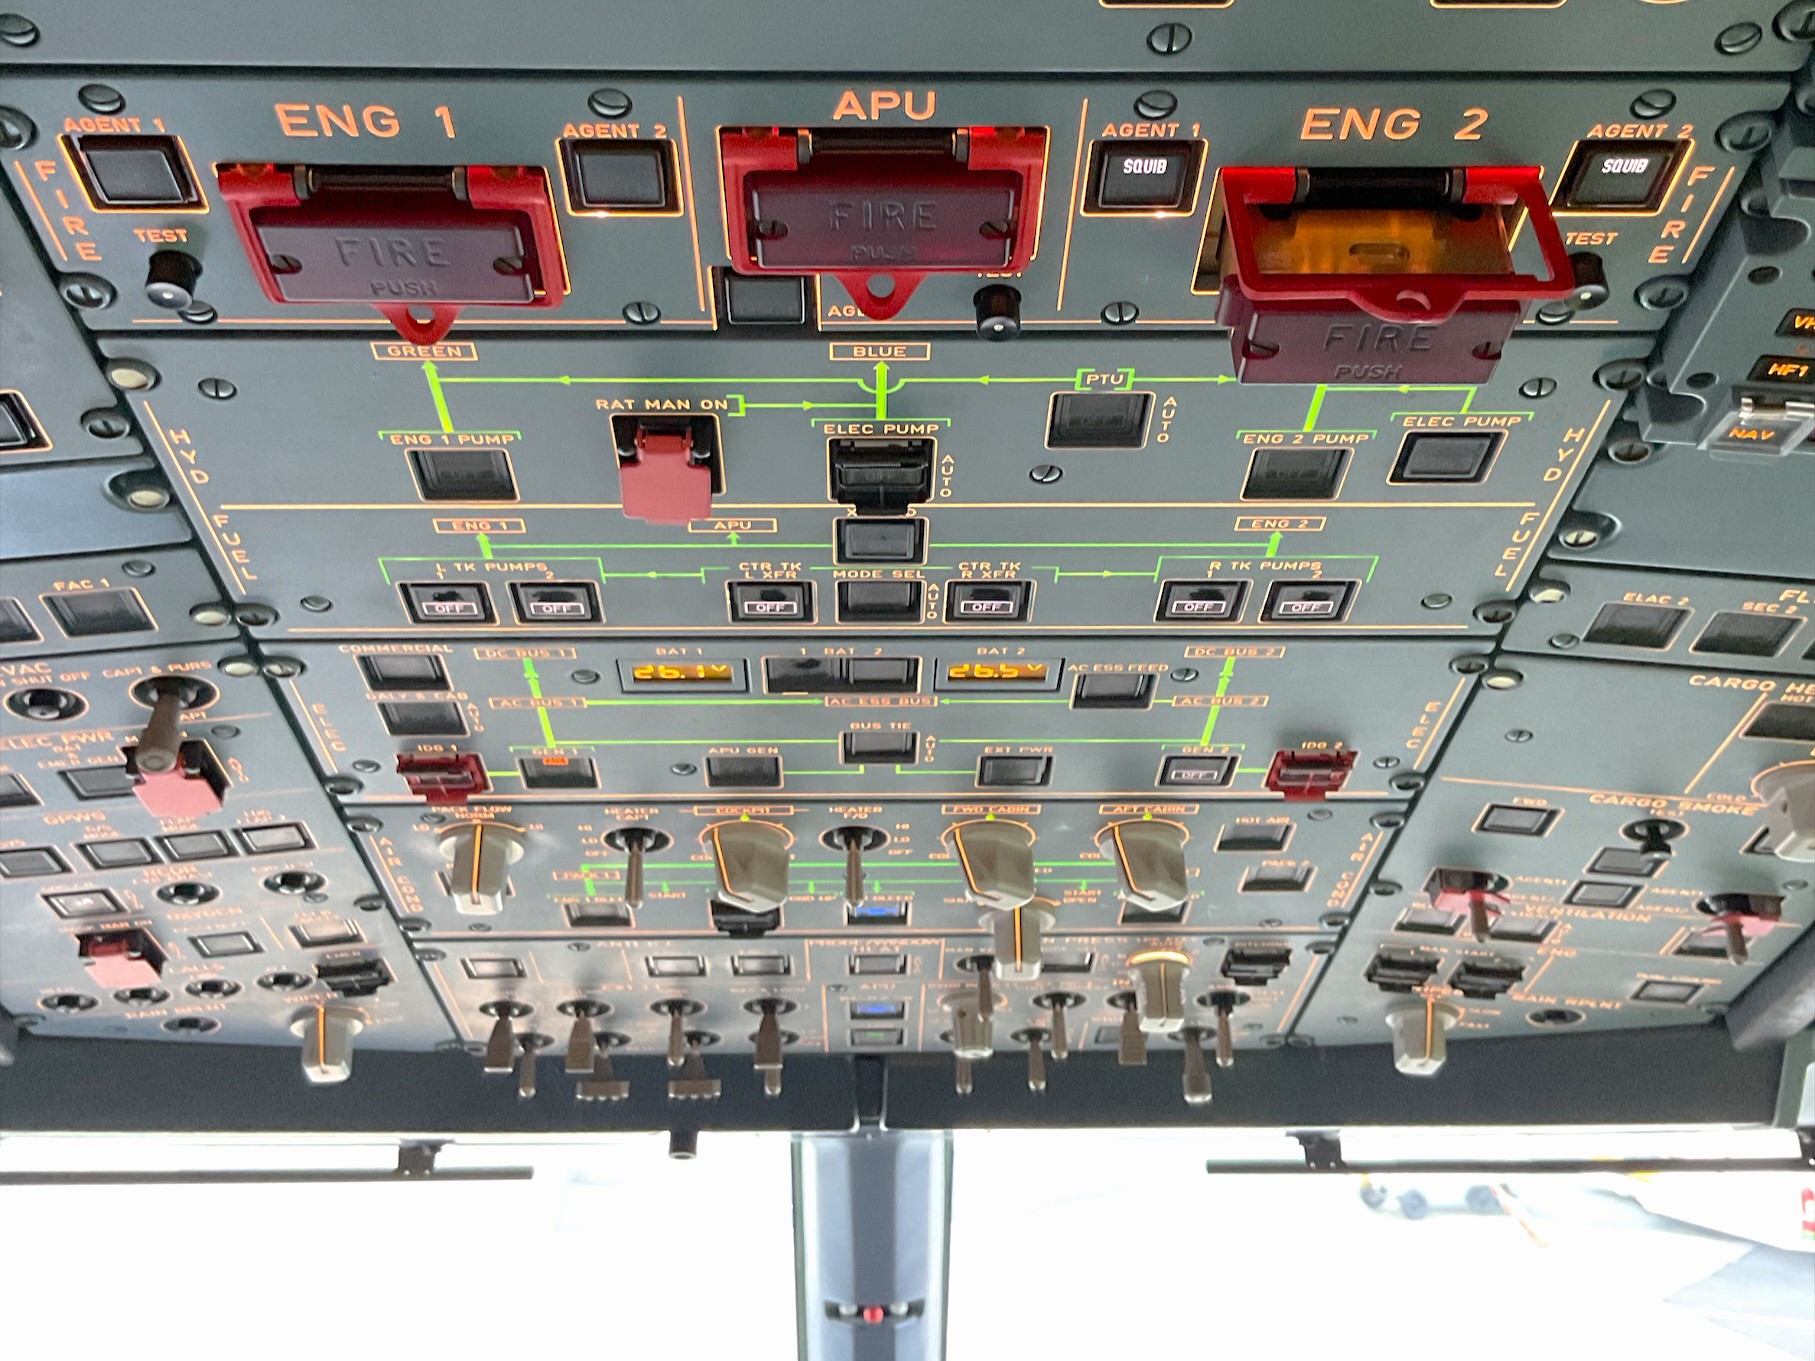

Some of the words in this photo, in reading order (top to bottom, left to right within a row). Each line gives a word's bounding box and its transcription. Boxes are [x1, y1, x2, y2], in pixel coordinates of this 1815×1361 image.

[832, 91, 937, 121] APU
[64, 118, 141, 132] AGENT
[154, 117, 166, 132] 1
[275, 103, 401, 138] ENG
[434, 106, 457, 139] 1
[1301, 108, 1421, 140] ENG
[1454, 108, 1489, 140] 2
[563, 124, 640, 139] AGENT
[654, 124, 667, 139] 2
[1102, 123, 1180, 137] AGENT
[1192, 123, 1201, 137] 1
[1587, 124, 1668, 138] AGENT
[1678, 124, 1695, 138] 2
[1123, 159, 1167, 174] SQUIB
[1601, 158, 1649, 173] SQUIB
[36, 161, 102, 263] FIRE
[830, 202, 938, 232] FIRE
[1648, 166, 1715, 263] FIRE
[134, 229, 188, 243] TEST
[1565, 232, 1618, 245] TEST
[333, 236, 452, 269] FIRE
[370, 281, 438, 297] PUSH
[1323, 323, 1440, 352] FIRE
[387, 345, 462, 358] GREEN
[853, 346, 907, 357] BLUE
[1334, 364, 1403, 379] PUSH
[1767, 363, 1810, 377] HF1
[1086, 373, 1124, 385] PTU
[595, 399, 635, 410] RAT
[644, 399, 691, 410] MAN
[701, 399, 728, 410] ON
[1156, 396, 1178, 444] AUTO
[1402, 416, 1456, 427] ELEC
[1463, 416, 1522, 427] PUMP
[823, 424, 875, 435] ELEC
[883, 424, 940, 435] PUMP
[1728, 427, 1775, 441] NAV
[390, 434, 437, 446] ENG
[441, 434, 450, 445] 1
[458, 434, 515, 446] PUMP
[1243, 433, 1285, 444] ENG
[1292, 433, 1305, 444] 2
[1312, 433, 1370, 444] PUMP
[169, 428, 210, 485] HYD
[1543, 428, 1586, 482] HYD
[939, 454, 954, 498] AUTO
[451, 521, 492, 531] ENG
[499, 521, 508, 531] 1
[713, 521, 752, 531] APU
[1251, 519, 1290, 529] ENG
[1297, 519, 1309, 529] 2
[213, 514, 257, 581] FUEL
[1494, 512, 1541, 577] FUEL
[453, 563, 475, 572] TK
[484, 562, 549, 572] PUMPS
[739, 562, 773, 571] CTR
[780, 562, 802, 571] TK
[958, 562, 992, 571] CTR
[999, 562, 1021, 571] TK
[1209, 561, 1221, 571] R
[1230, 561, 1251, 571] TK
[1260, 561, 1322, 571] PUMPS
[745, 570, 754, 579] L
[762, 570, 798, 579] XFR
[832, 570, 884, 579] MODE
[892, 570, 926, 579] SEL
[961, 570, 974, 579] R
[981, 570, 1016, 579] XFR
[54, 580, 94, 591] FAC
[100, 578, 110, 588] 1
[1623, 592, 1672, 605] ELAC
[1678, 596, 1691, 606] 2
[1779, 589, 1815, 605] FL
[435, 604, 465, 614] OFF
[542, 604, 572, 614] OFF
[756, 603, 785, 613] OFF
[972, 603, 1002, 612] OFF
[1183, 603, 1213, 612] OFF
[1291, 603, 1323, 612] OFF
[1742, 601, 1780, 612] SEC
[338, 644, 454, 653] COMMERCIAL
[515, 649, 550, 658] BUS
[656, 647, 688, 656] BAT
[824, 647, 856, 656] BAT
[874, 647, 884, 655] 2
[976, 647, 1009, 656] BAT
[1016, 647, 1027, 656] 2
[1227, 648, 1261, 656] BUS
[1068, 664, 1087, 672] AC
[1093, 664, 1122, 672] ESS
[1128, 664, 1169, 673] FEED
[1689, 674, 1776, 692] CARGO
[1785, 682, 1815, 695] HE
[530, 698, 563, 707] BUS
[900, 697, 931, 706] BUS
[1181, 697, 1204, 706] AC
[1211, 697, 1246, 706] BUS
[850, 722, 880, 730] BUS
[889, 722, 912, 730] TIE
[708, 747, 740, 755] APU
[1512, 796, 1548, 807] FWD
[1589, 793, 1668, 809] CARGO
[1679, 800, 1759, 817] SMOKE
[1525, 904, 1652, 923] VENTILATION
